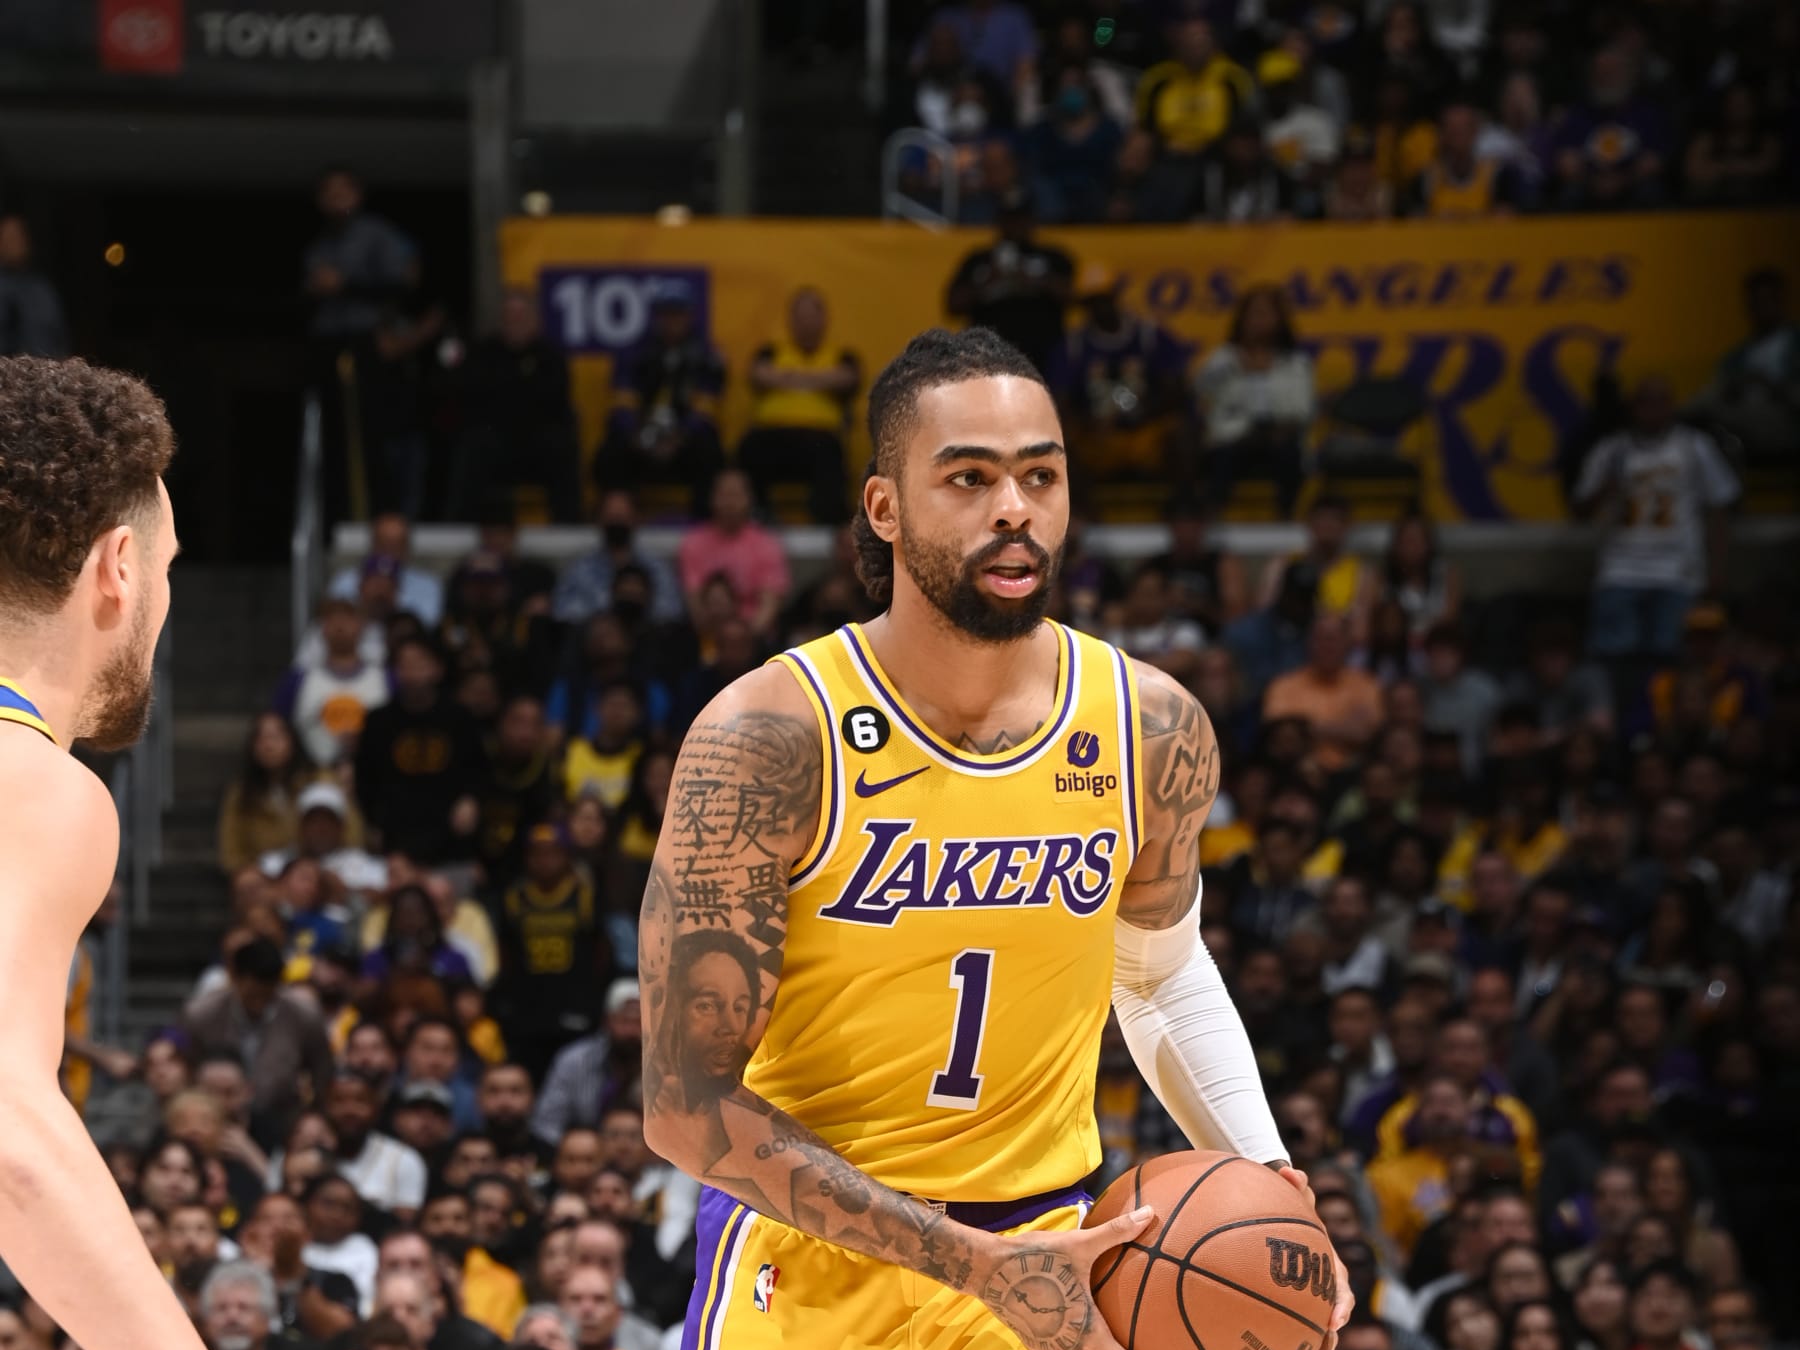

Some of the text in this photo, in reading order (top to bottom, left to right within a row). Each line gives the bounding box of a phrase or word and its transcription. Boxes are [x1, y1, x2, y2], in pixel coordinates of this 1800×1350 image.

[196, 13, 394, 60] TOYOTA
[1284, 258, 1634, 310] ANGELES
[851, 712, 879, 748] 6
[1055, 771, 1117, 797] bibigo
[816, 818, 1119, 929] LAKERS
[926, 947, 996, 1111] 1
